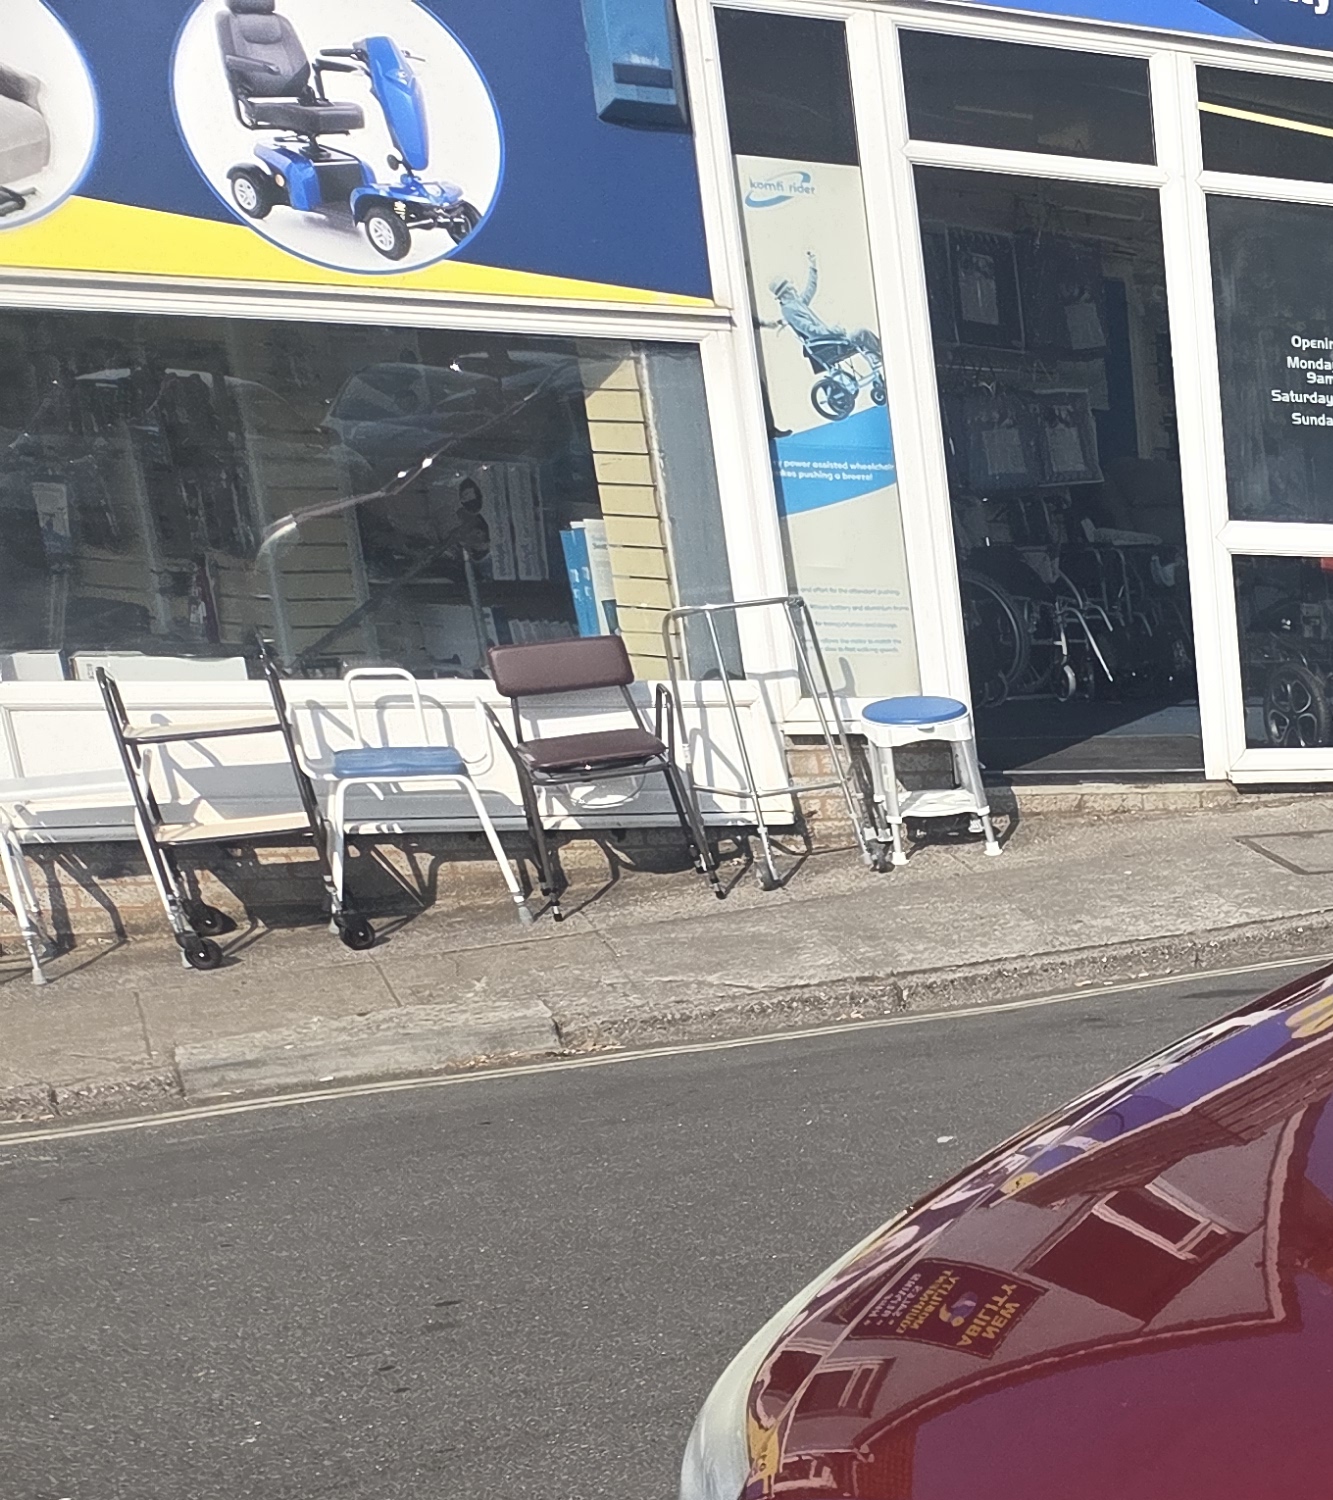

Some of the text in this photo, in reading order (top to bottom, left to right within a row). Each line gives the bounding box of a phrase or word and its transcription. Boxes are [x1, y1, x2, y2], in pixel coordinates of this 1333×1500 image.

[788, 183, 816, 195] rider
[1271, 390, 1333, 407] Saturday
[798, 470, 833, 481] pushing
